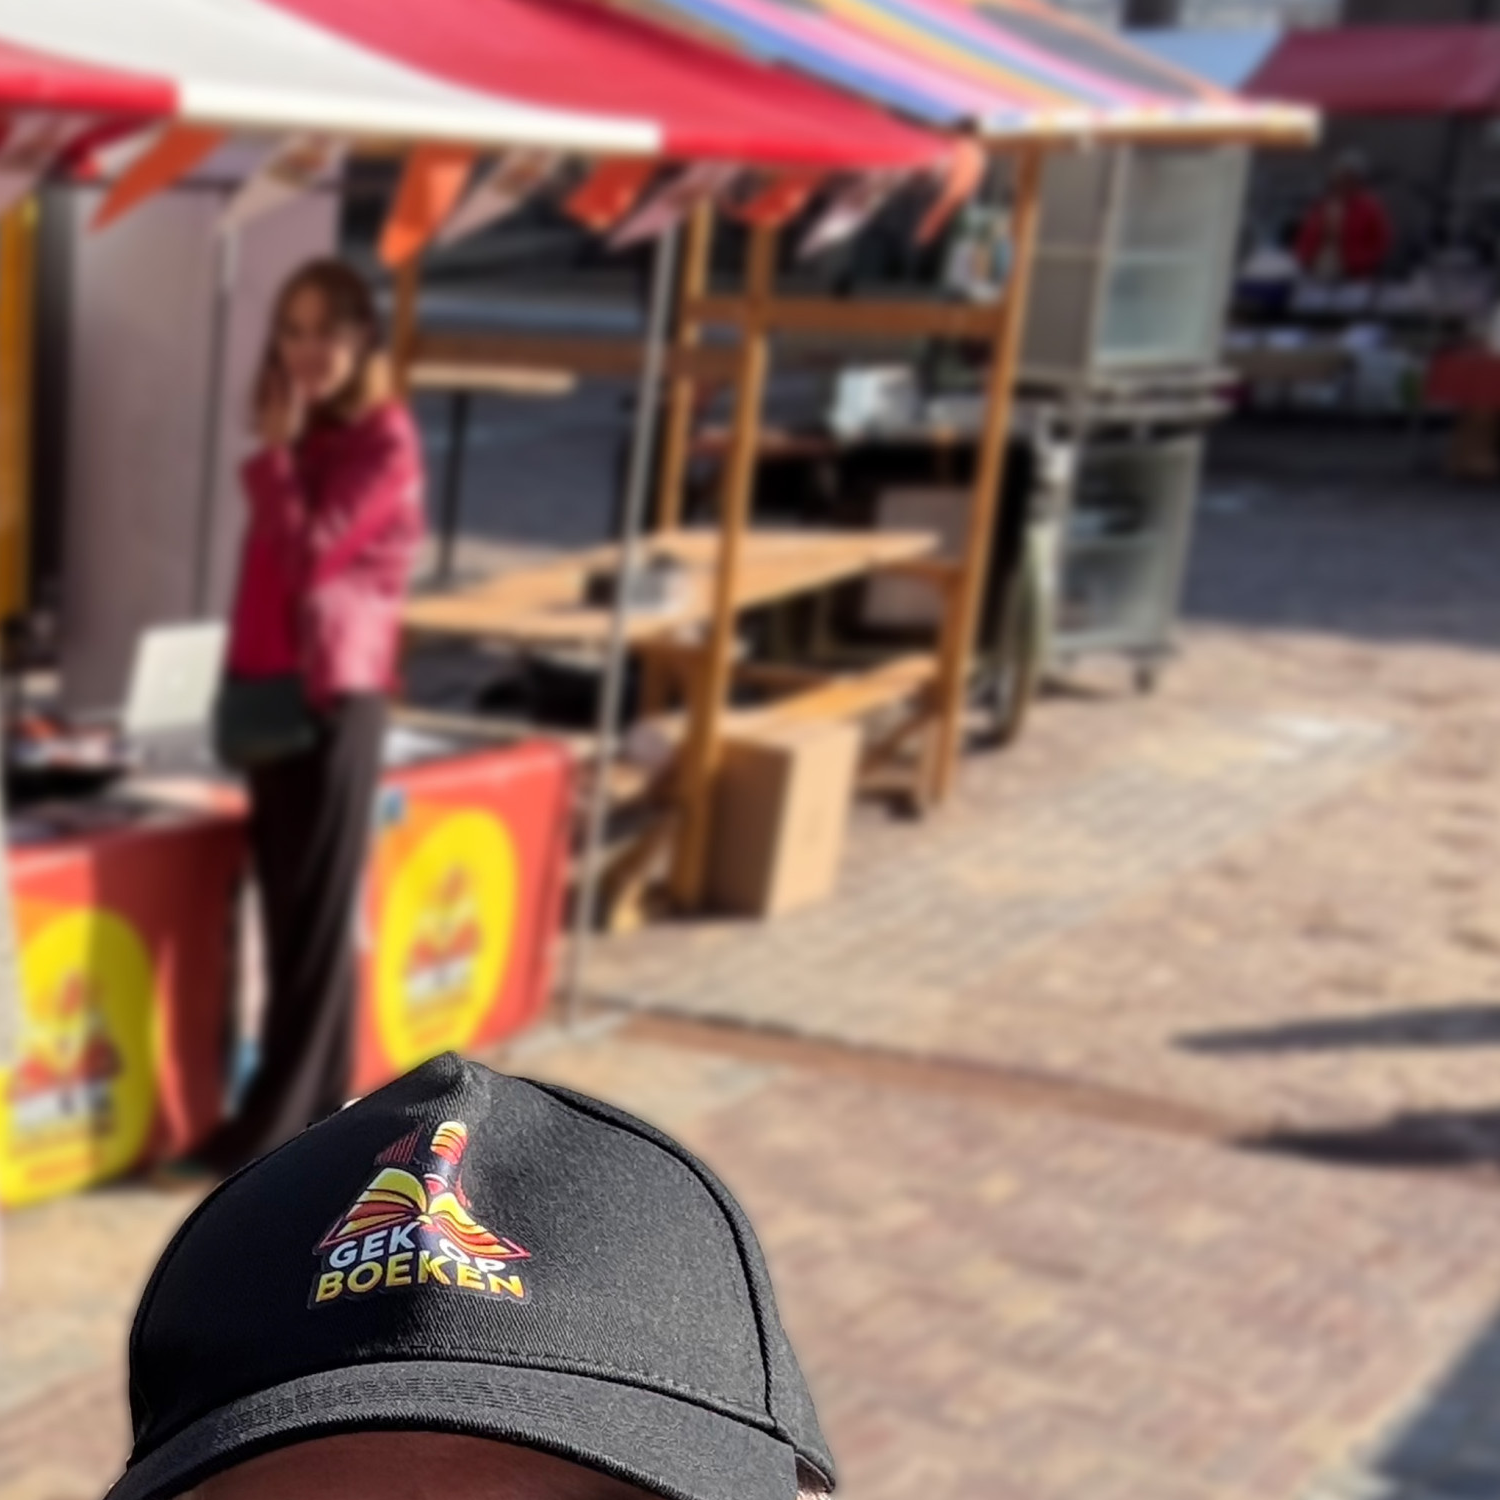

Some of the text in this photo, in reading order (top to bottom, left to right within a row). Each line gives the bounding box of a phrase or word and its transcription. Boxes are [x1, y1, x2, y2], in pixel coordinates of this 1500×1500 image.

[329, 1222, 506, 1273] GEK OP
[315, 1251, 524, 1303] BOEKEN
